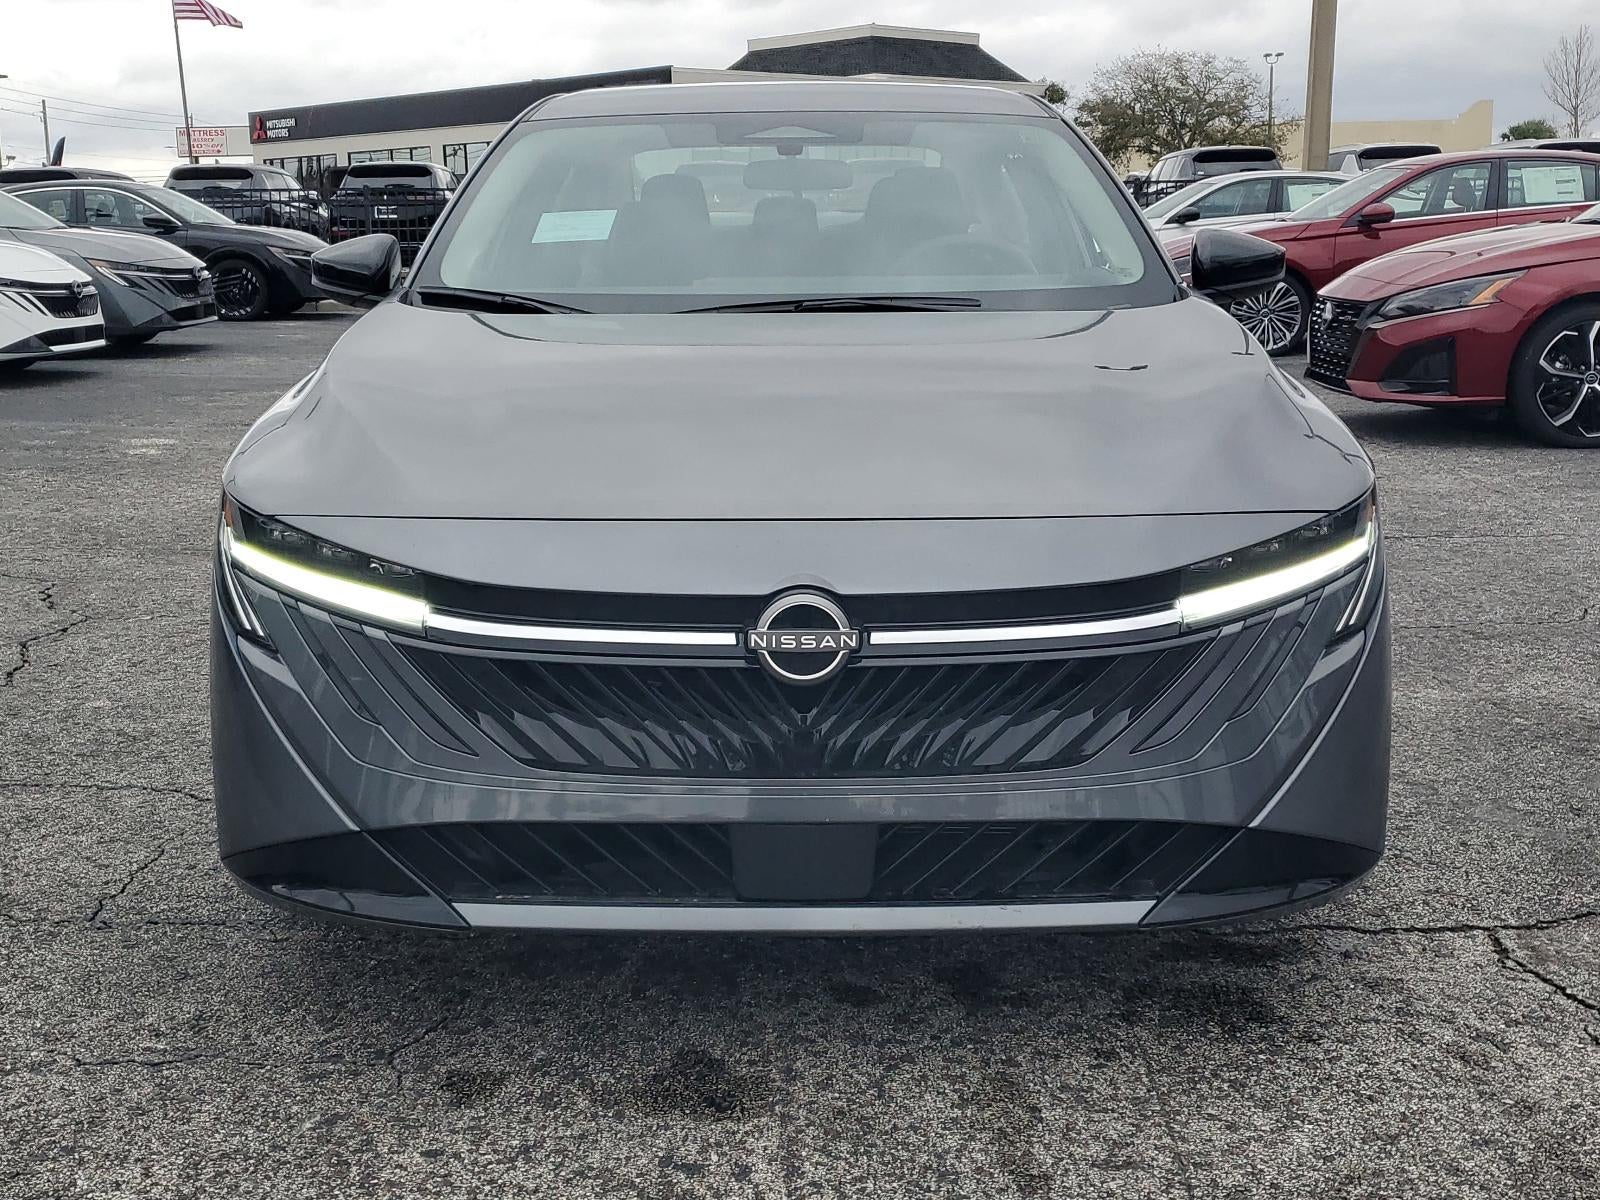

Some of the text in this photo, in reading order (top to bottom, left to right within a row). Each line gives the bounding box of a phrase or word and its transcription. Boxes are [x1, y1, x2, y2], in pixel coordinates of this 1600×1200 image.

[266, 118, 296, 129] MITSUBISHI
[267, 128, 290, 139] MOTORS
[750, 634, 857, 649] NISSAN
